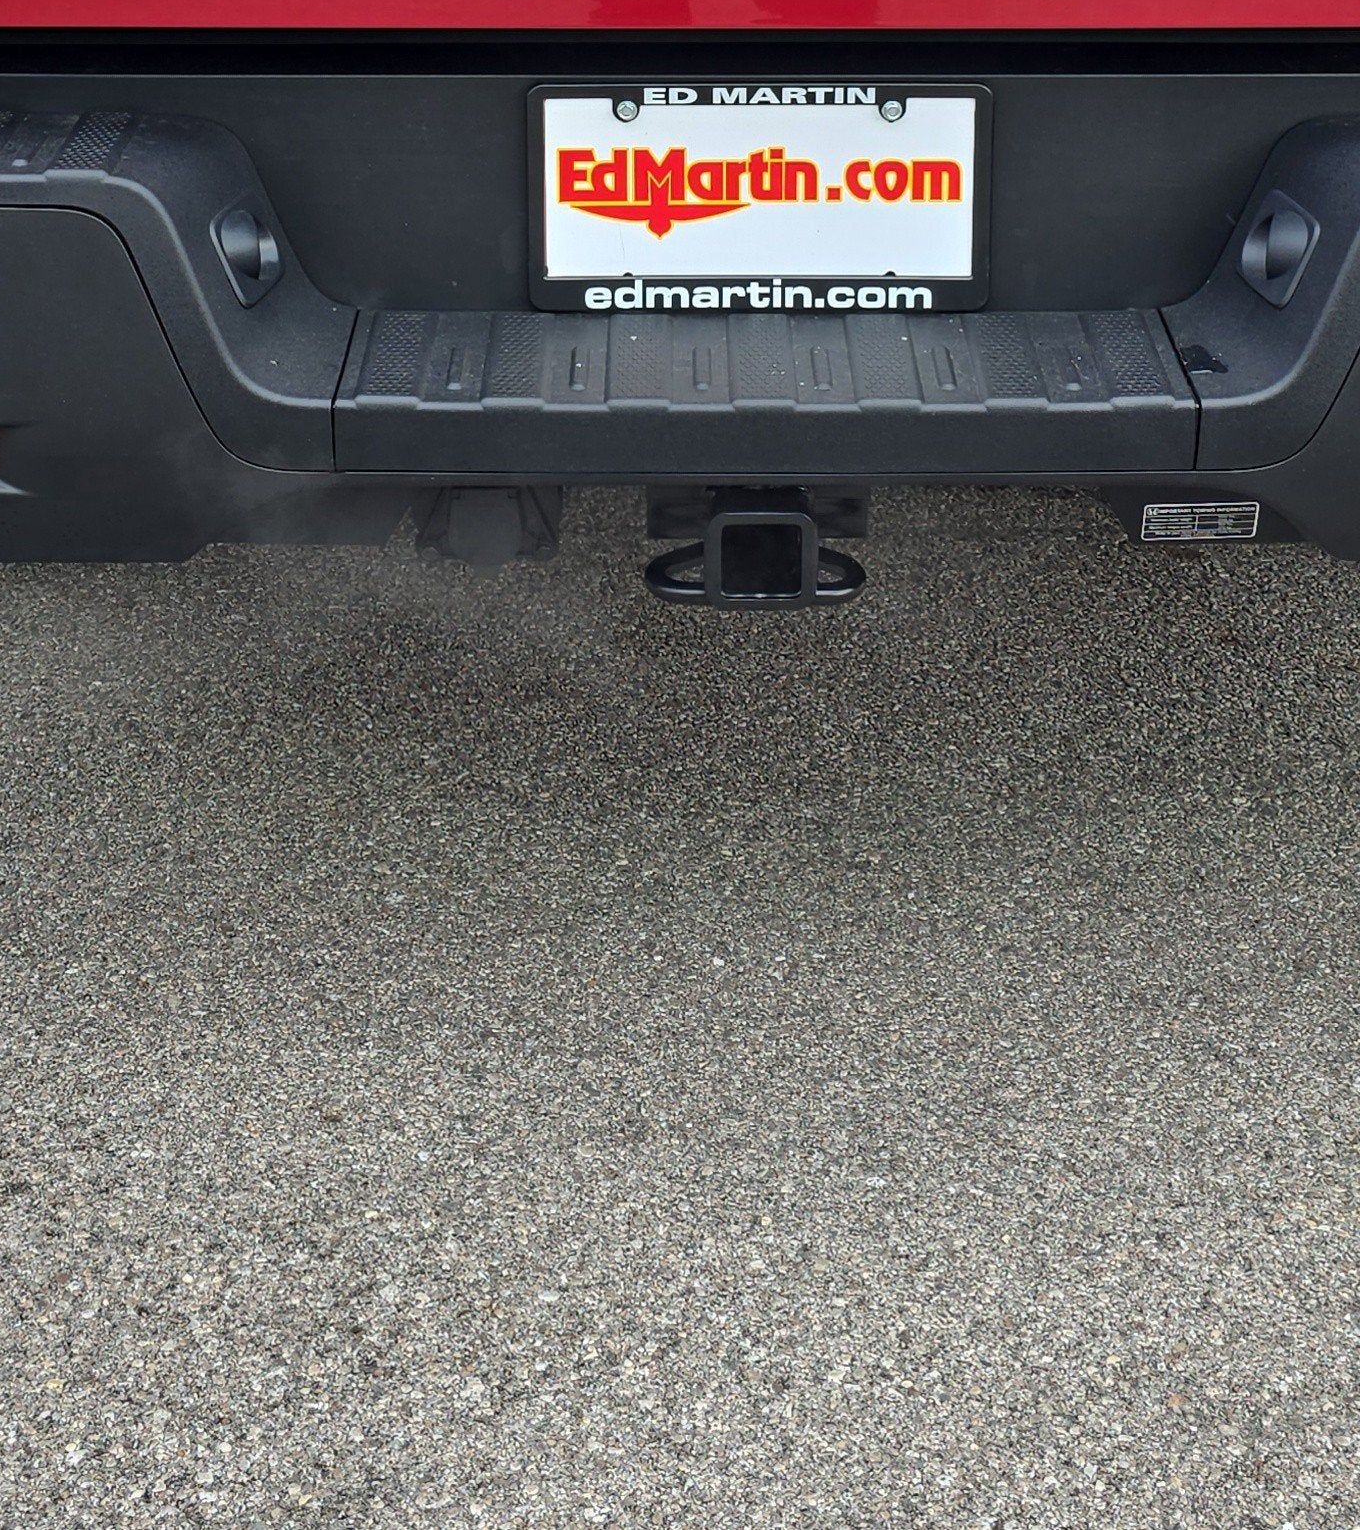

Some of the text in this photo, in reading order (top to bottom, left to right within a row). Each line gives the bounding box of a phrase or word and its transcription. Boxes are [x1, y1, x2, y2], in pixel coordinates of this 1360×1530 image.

[643, 86, 877, 105] ED MARTIN
[584, 278, 933, 310] edmartin.com
